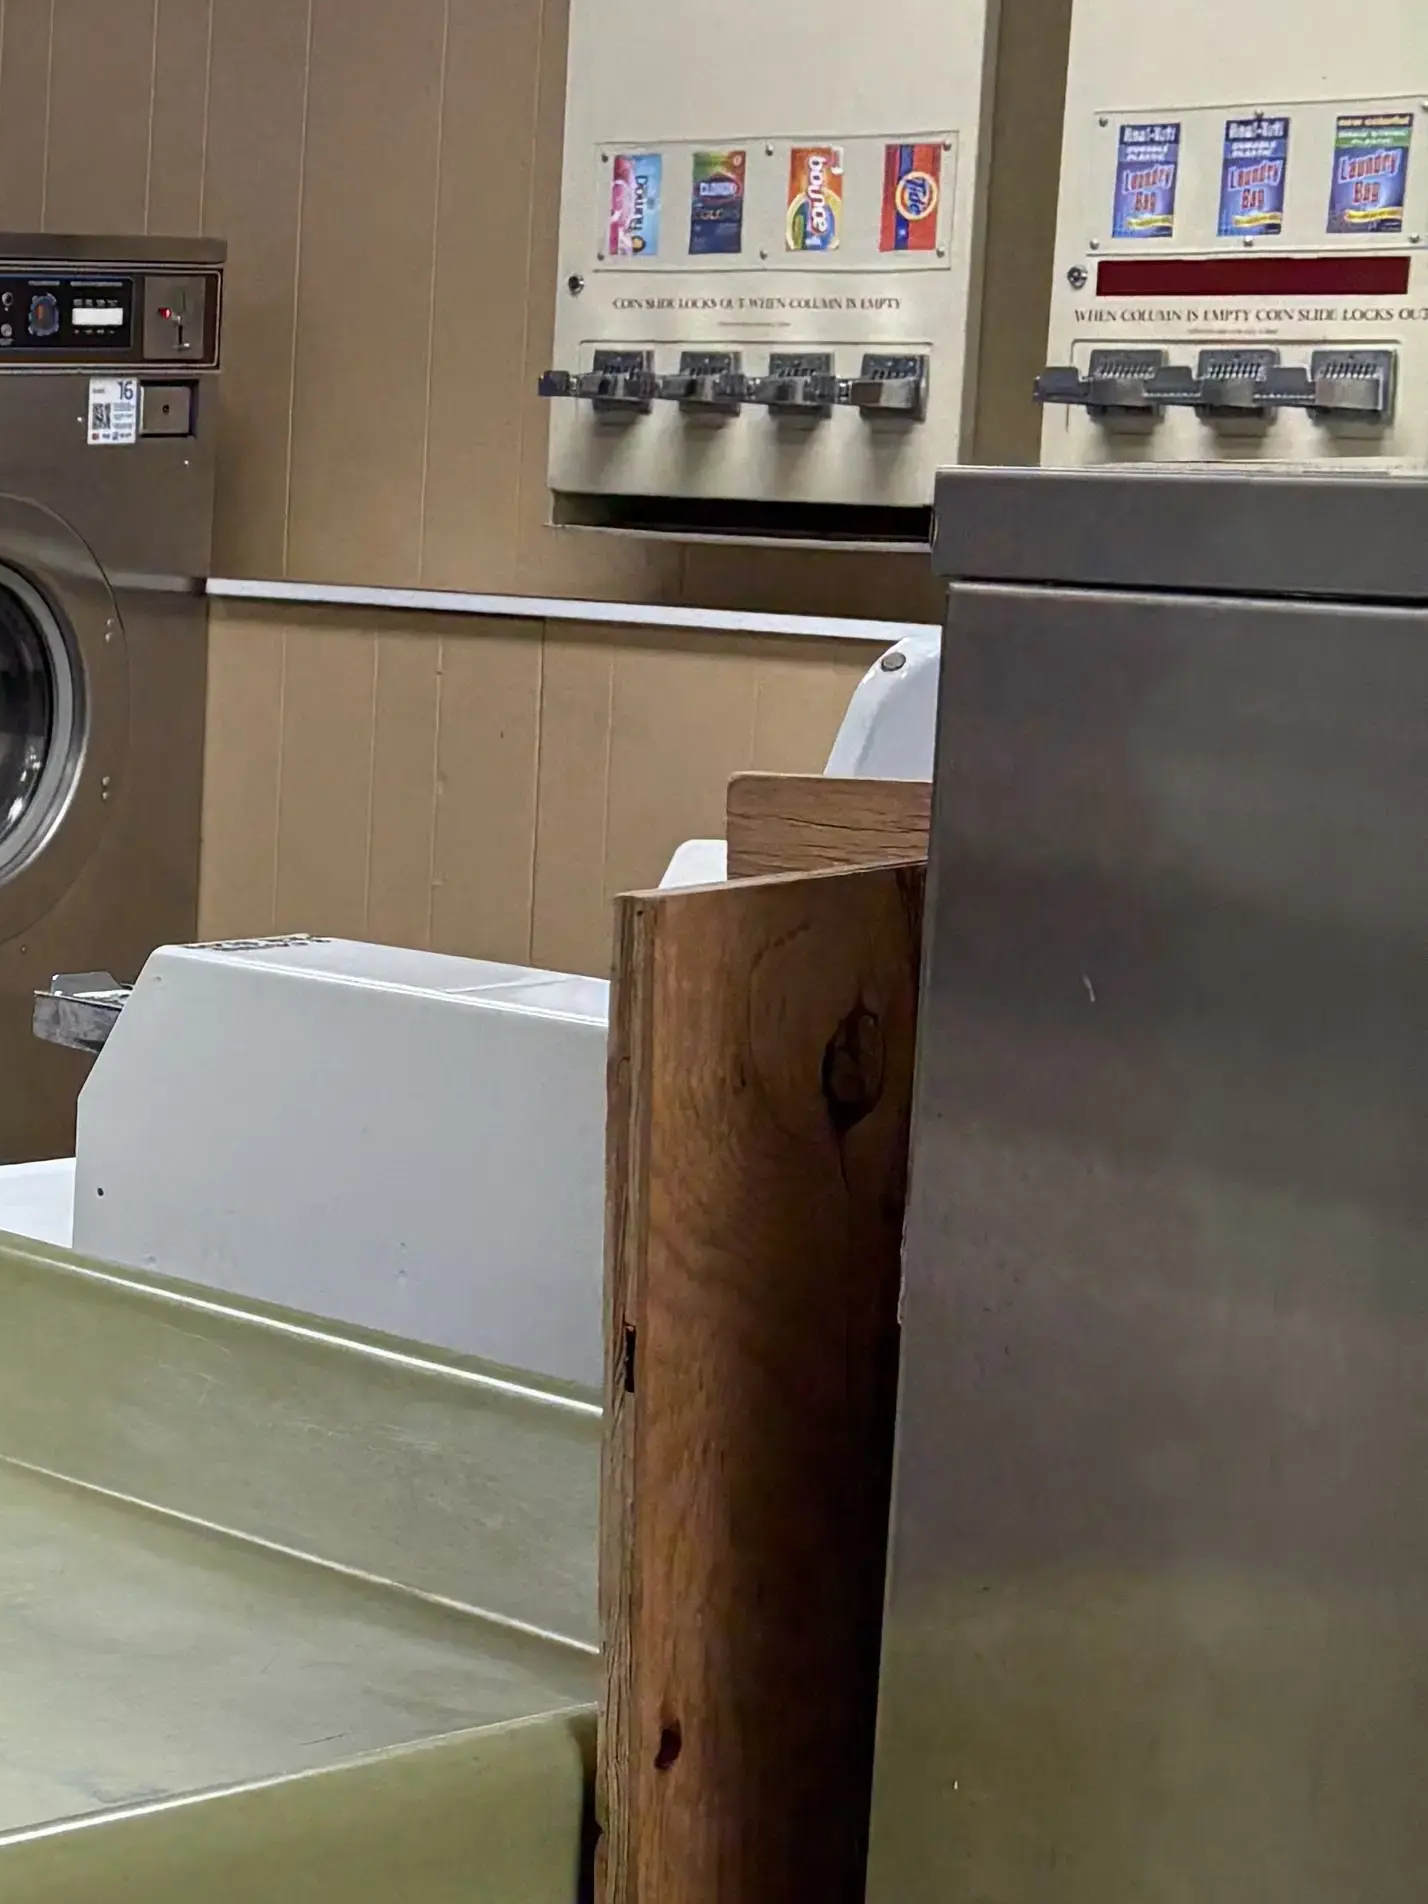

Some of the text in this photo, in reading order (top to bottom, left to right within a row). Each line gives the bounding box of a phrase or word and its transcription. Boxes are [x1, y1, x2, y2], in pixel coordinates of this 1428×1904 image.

[904, 176, 928, 217] Tide
[1343, 308, 1394, 322] LOCKS
[117, 380, 134, 401] 16
